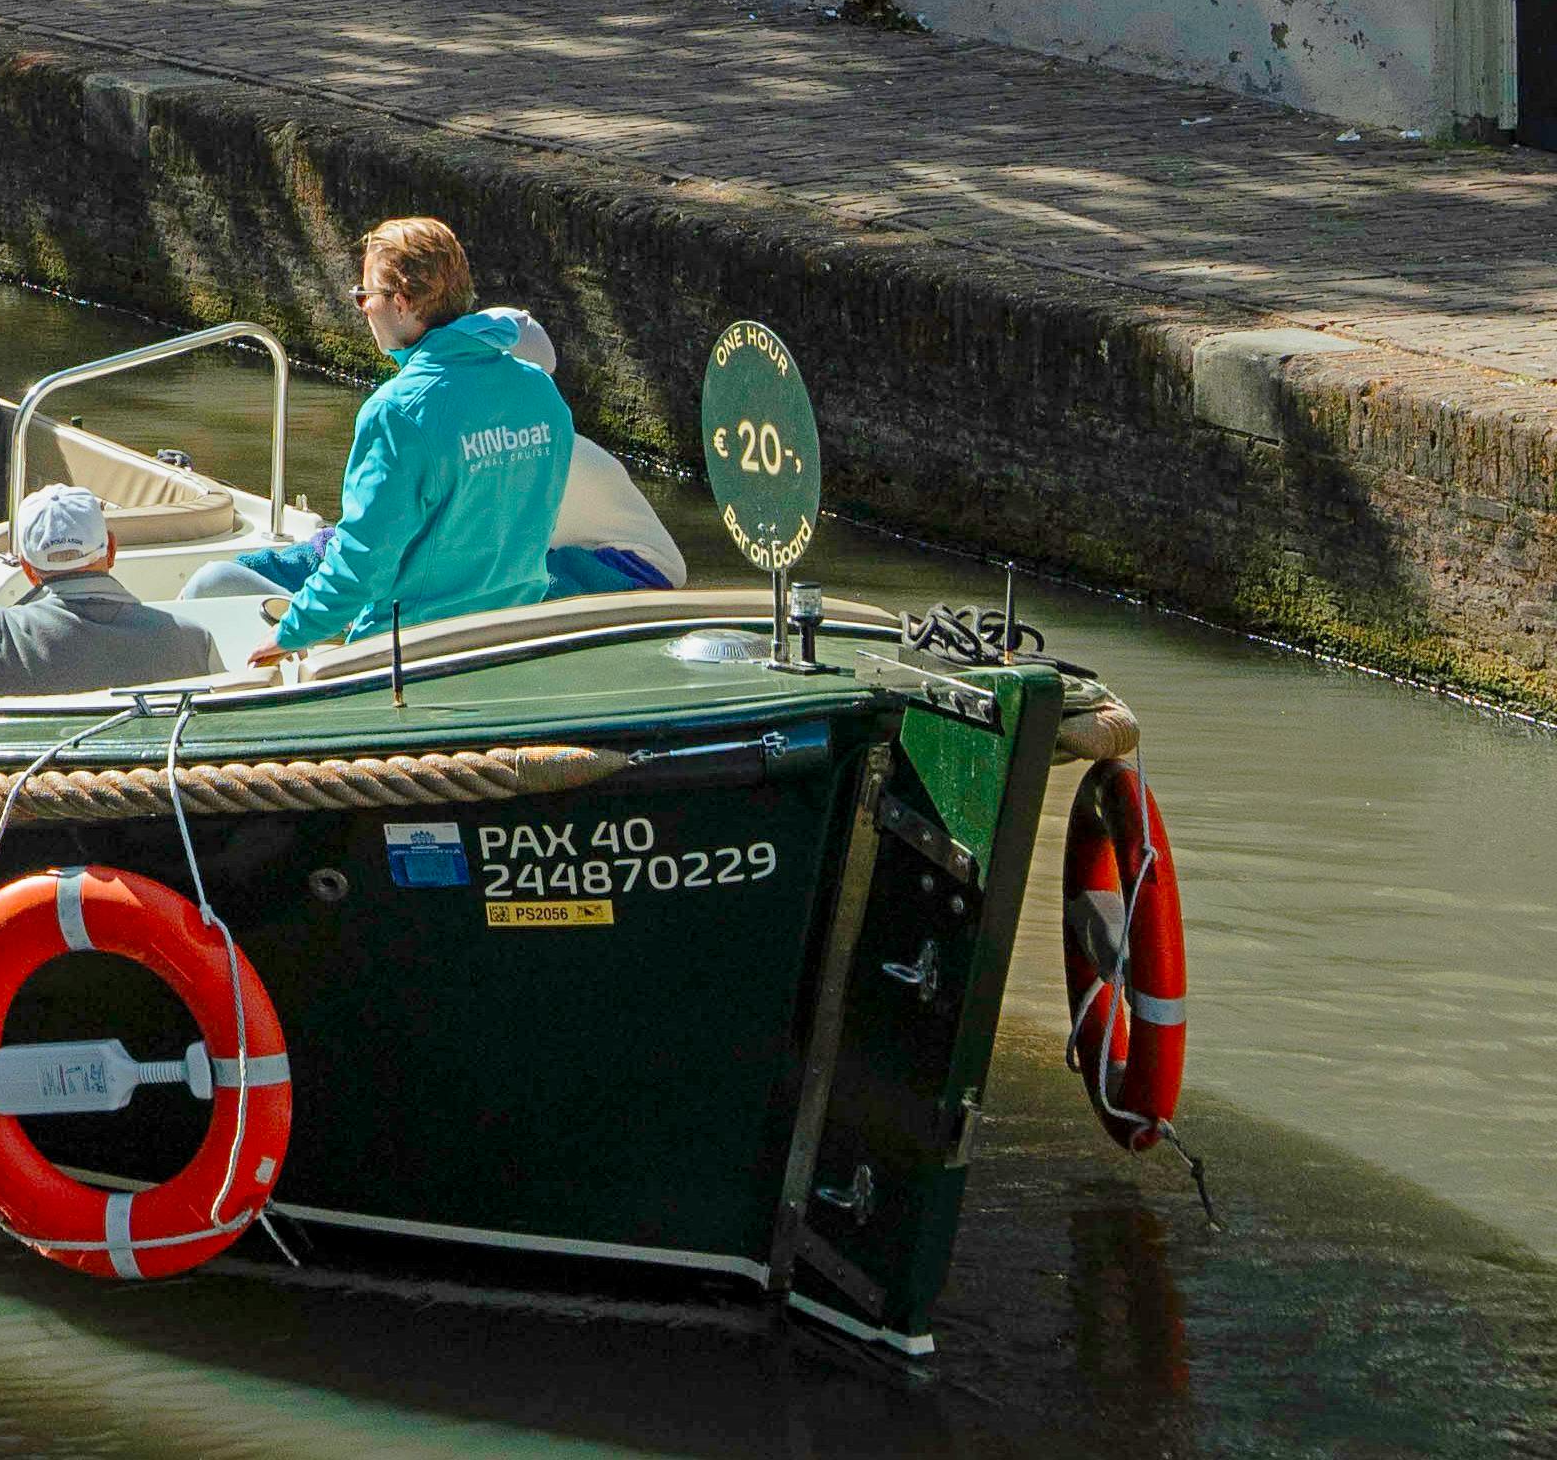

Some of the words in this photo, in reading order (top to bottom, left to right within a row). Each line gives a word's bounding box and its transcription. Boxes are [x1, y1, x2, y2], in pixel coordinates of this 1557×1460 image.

[716, 327, 744, 367] ONE
[746, 325, 789, 378] HOUR
[460, 421, 552, 461] KINboat
[510, 446, 551, 462] CRUISE
[713, 427, 729, 458] €
[724, 504, 750, 551] Bar
[750, 543, 770, 568] on
[772, 514, 812, 569] board
[478, 823, 579, 860] PAX
[591, 817, 655, 854] 40
[482, 842, 777, 898] 244870229
[516, 907, 569, 922] PS2056
